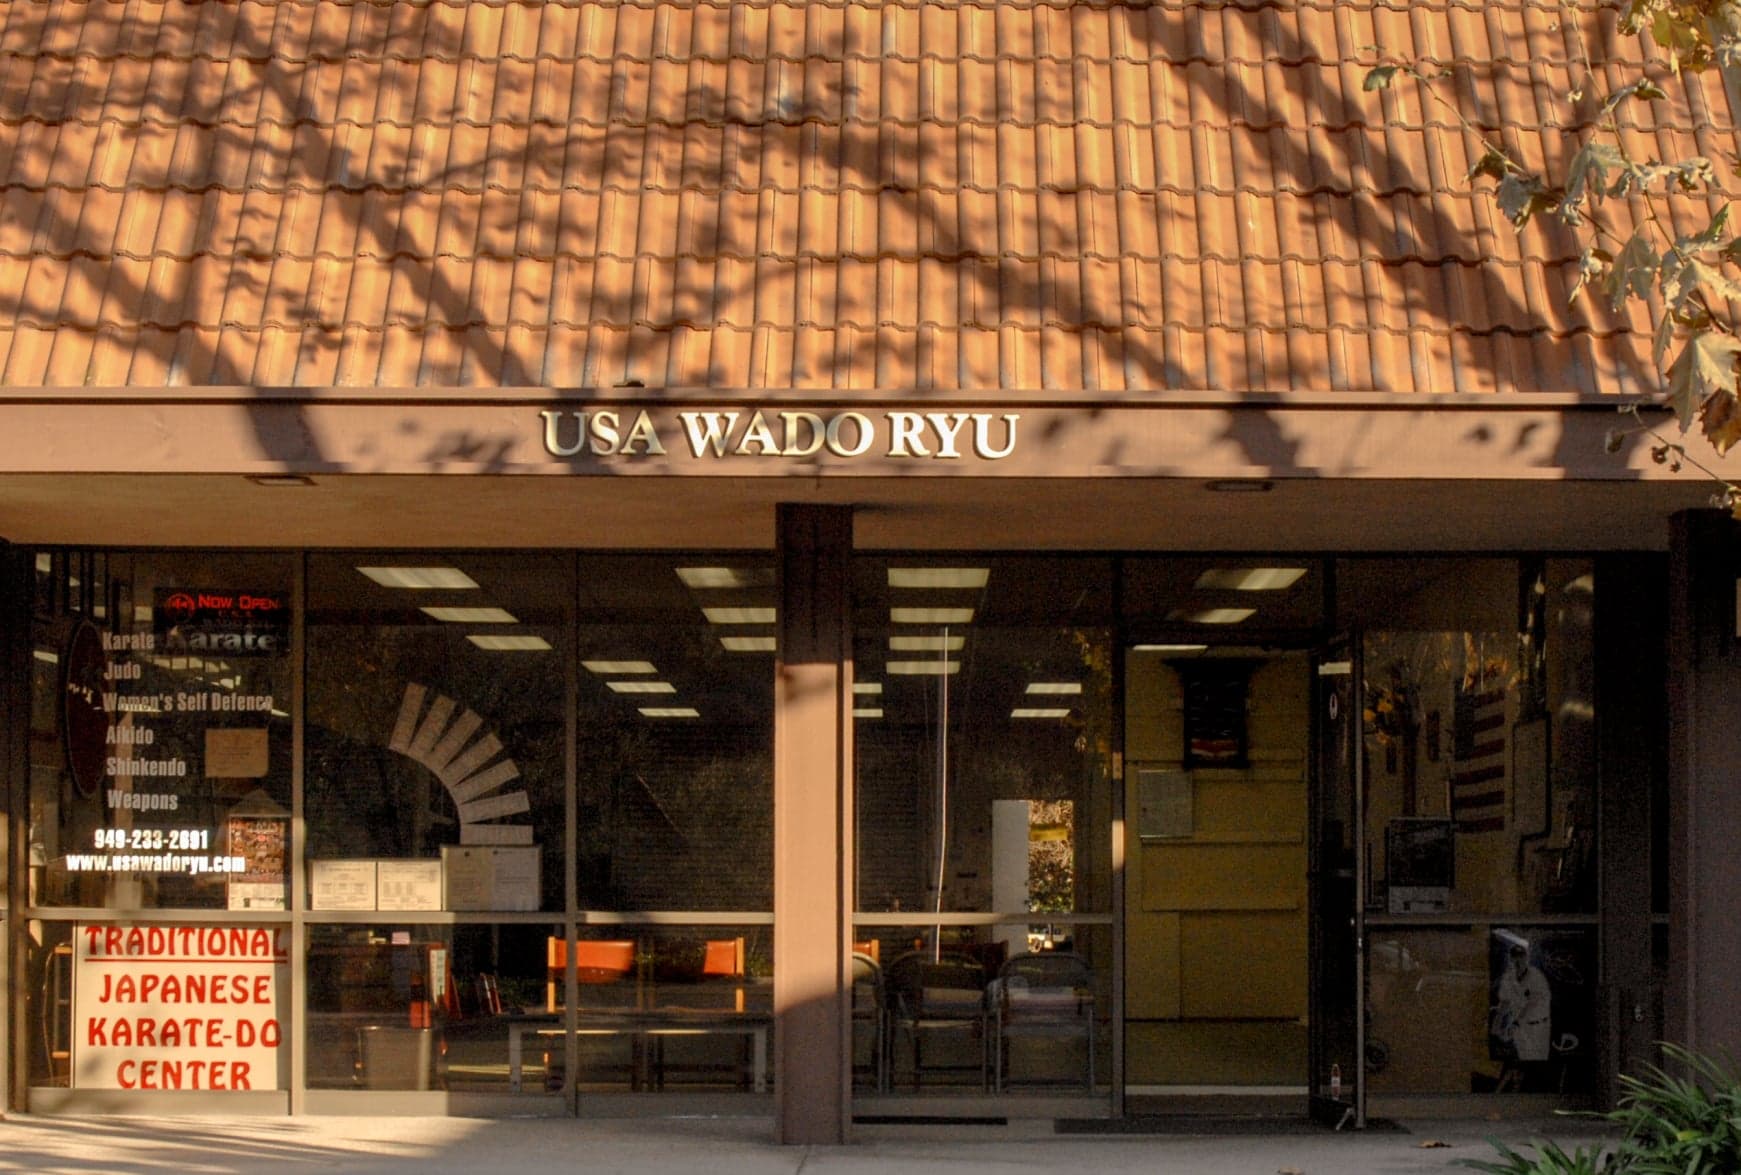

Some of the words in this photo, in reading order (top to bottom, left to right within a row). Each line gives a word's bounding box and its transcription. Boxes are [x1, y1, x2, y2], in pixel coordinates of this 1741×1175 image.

[540, 409, 665, 457] USA
[678, 410, 874, 458] WADO
[887, 411, 1020, 459] RYU
[198, 594, 233, 609] NOW
[239, 594, 279, 609] OPEN
[103, 632, 155, 650] Karate
[103, 661, 141, 680] Judo
[103, 692, 173, 713] Women's
[177, 692, 208, 713] Self
[212, 692, 273, 713] Defence
[106, 726, 154, 745] Aikido
[106, 757, 186, 776] Shinkendo
[107, 790, 178, 812] Weapons
[66, 852, 246, 875] www.usawadoryu.com
[85, 925, 287, 957] TRADITIONAL
[99, 974, 272, 1004] JAPANESE
[87, 1017, 282, 1048] KARATE-DO
[117, 1060, 251, 1090] CENTER
